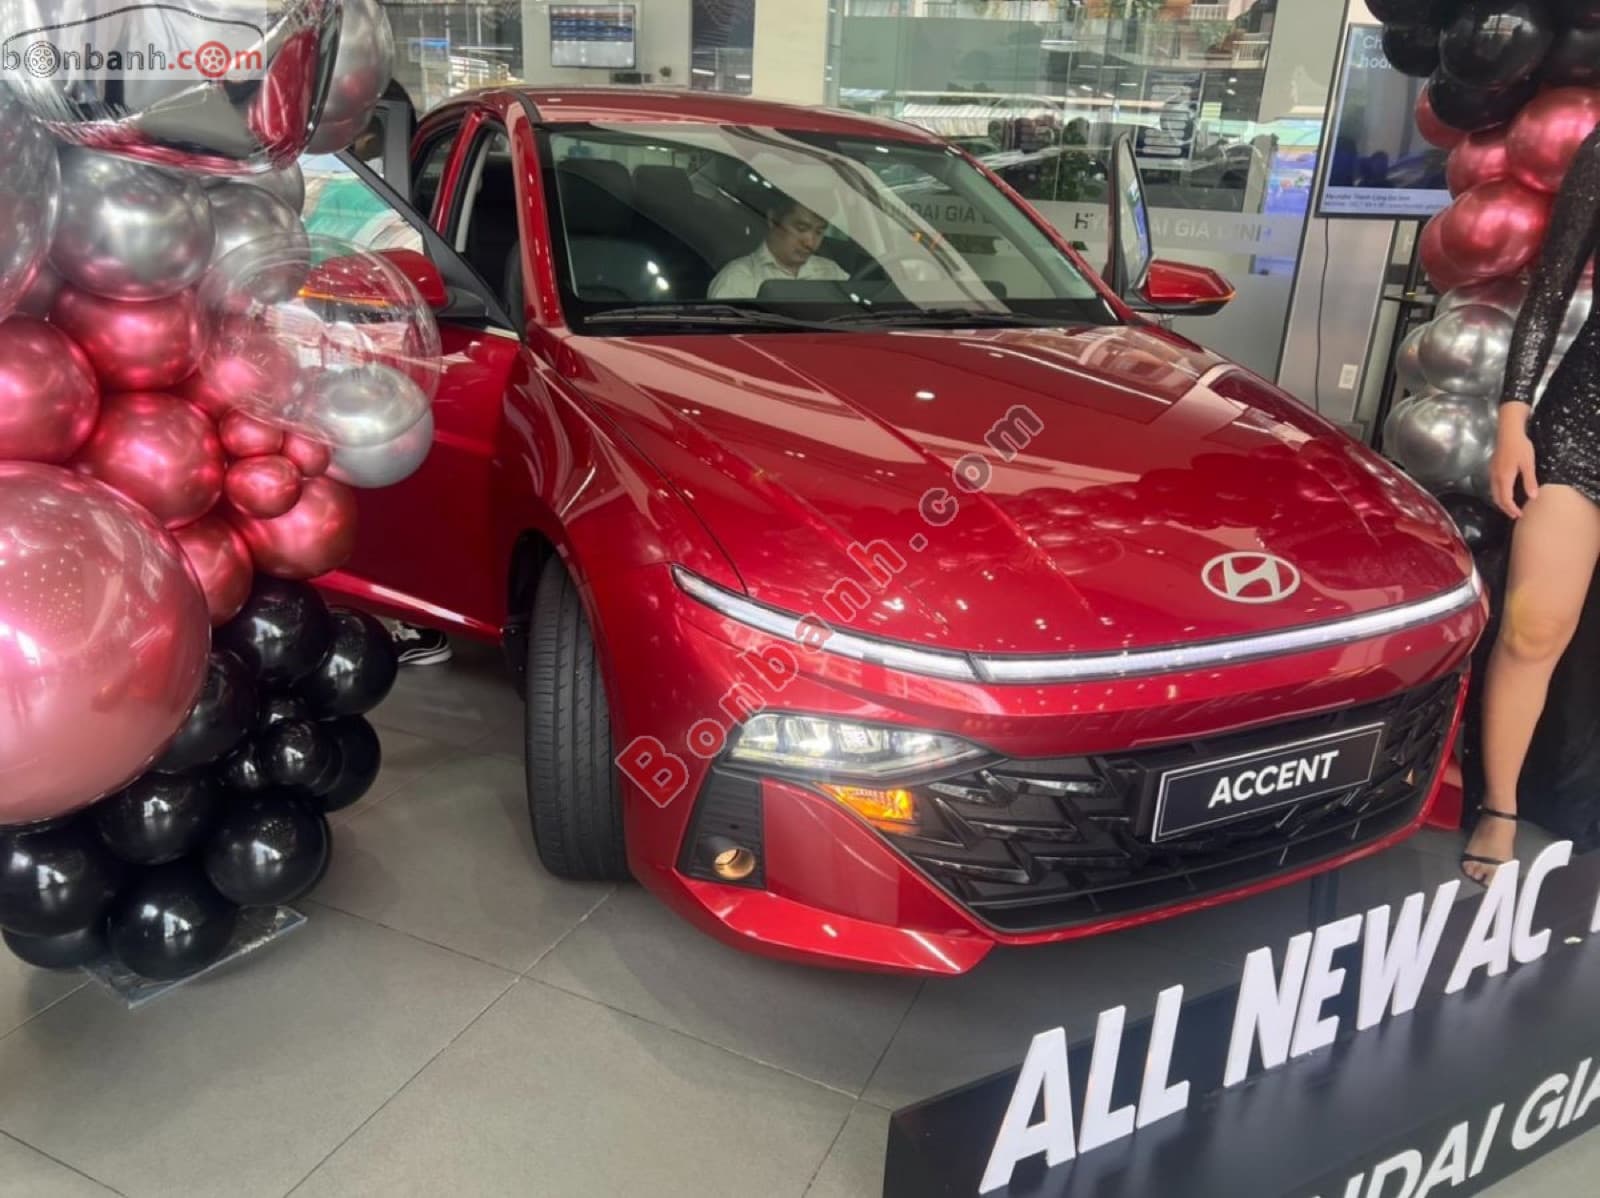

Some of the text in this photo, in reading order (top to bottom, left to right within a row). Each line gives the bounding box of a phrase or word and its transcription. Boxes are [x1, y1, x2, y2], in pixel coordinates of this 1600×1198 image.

[1363, 35, 1383, 49] Ch
[945, 205, 976, 223] GIA
[1175, 218, 1210, 240] GIA
[1208, 750, 1339, 809] ACCENT
[978, 984, 1190, 1196] ALL
[1223, 879, 1460, 1087] NEW
